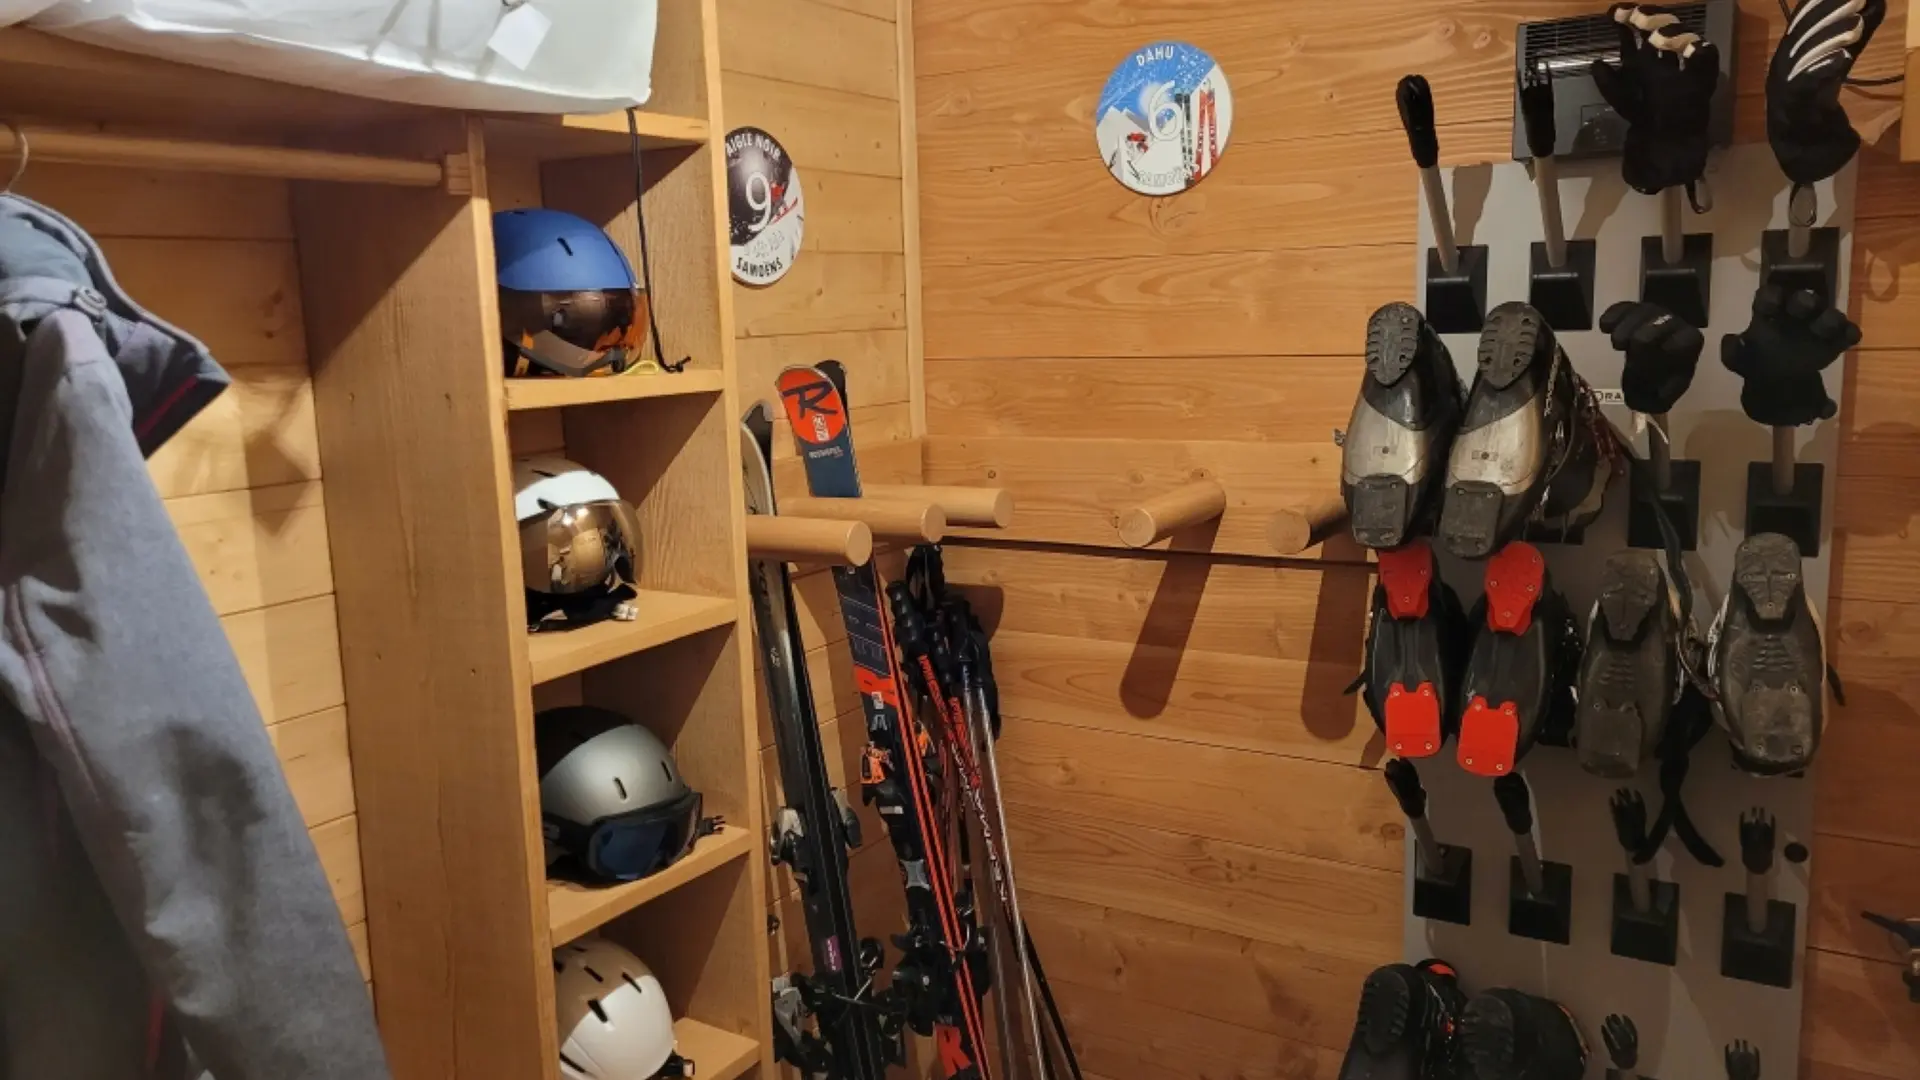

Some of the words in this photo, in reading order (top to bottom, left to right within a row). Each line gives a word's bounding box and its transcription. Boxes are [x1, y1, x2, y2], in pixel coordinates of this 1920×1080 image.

[1136, 45, 1174, 66] DAHU
[1148, 79, 1182, 141] 6
[755, 133, 781, 161] NOIR
[746, 172, 772, 232] 9
[782, 380, 839, 419] R
